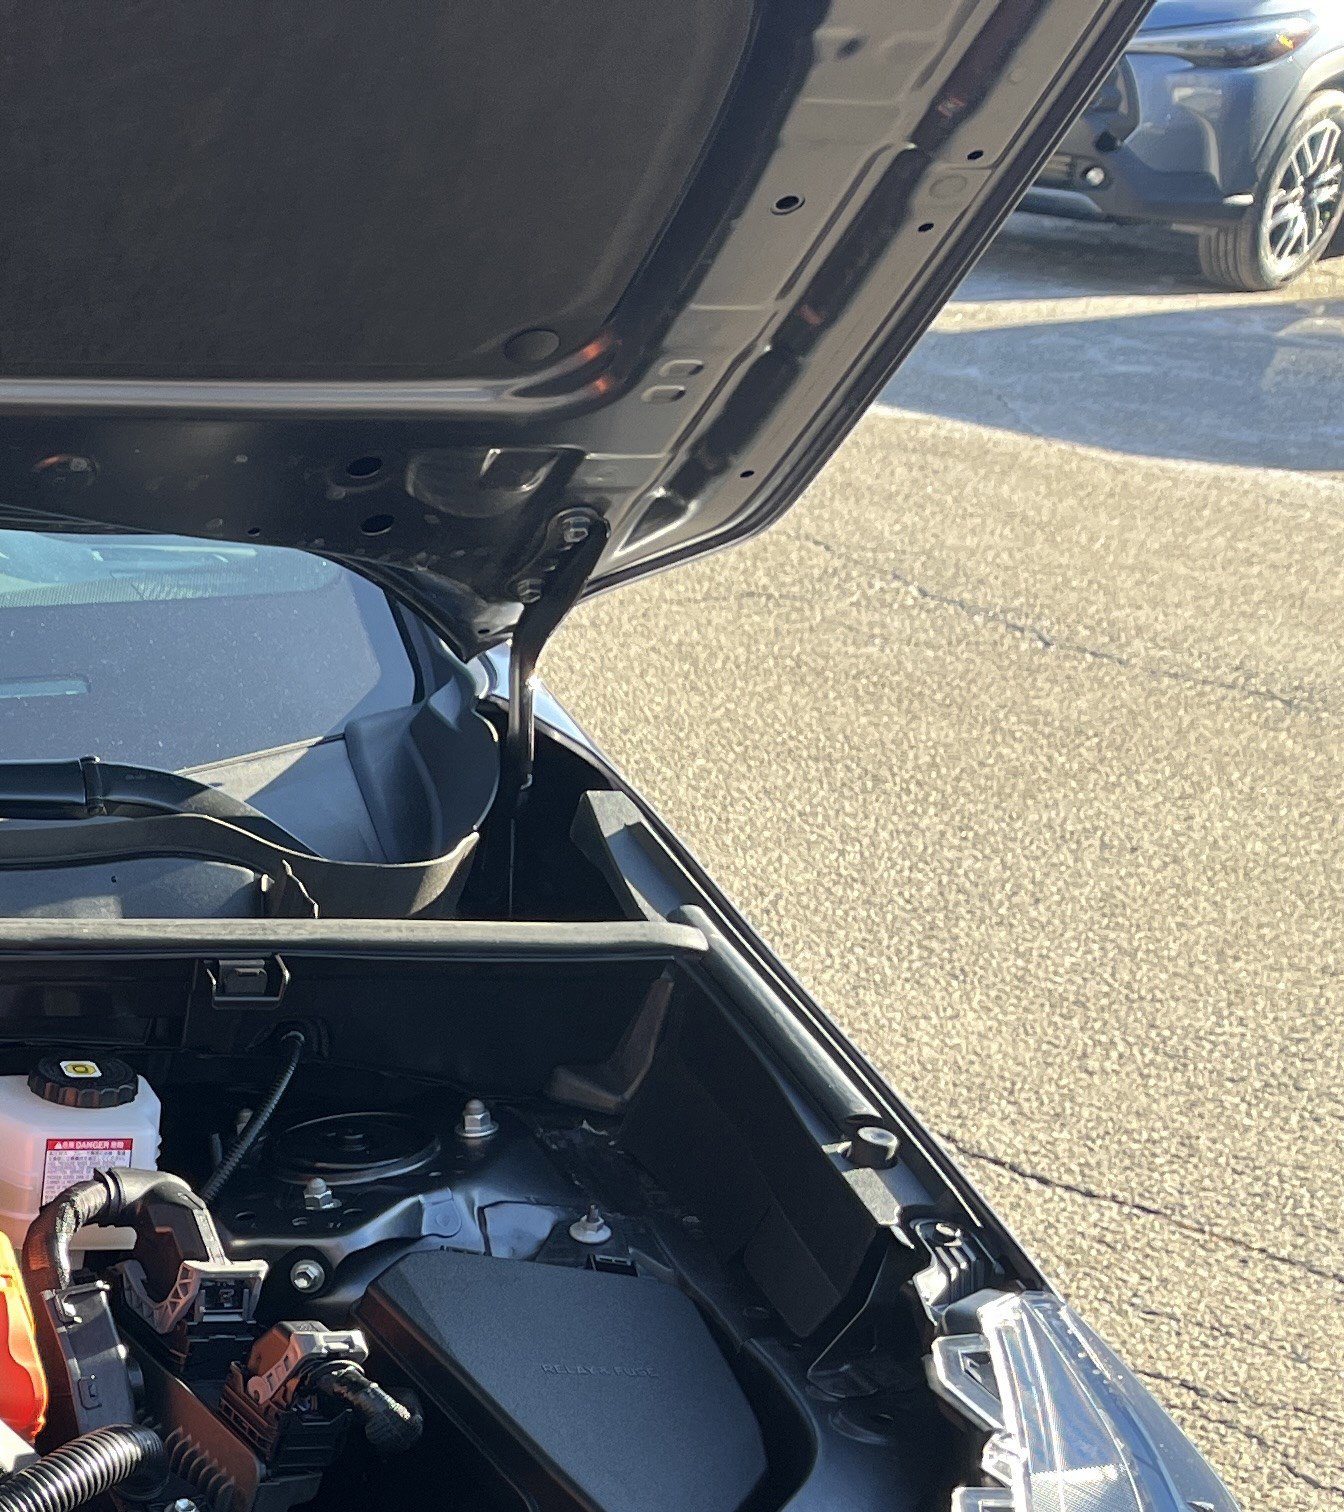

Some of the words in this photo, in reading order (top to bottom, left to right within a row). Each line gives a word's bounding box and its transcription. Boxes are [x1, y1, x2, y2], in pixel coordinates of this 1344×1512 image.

[75, 1140, 110, 1150] DANGER
[541, 1363, 594, 1376] RELAY
[613, 1365, 660, 1379] FUSE
